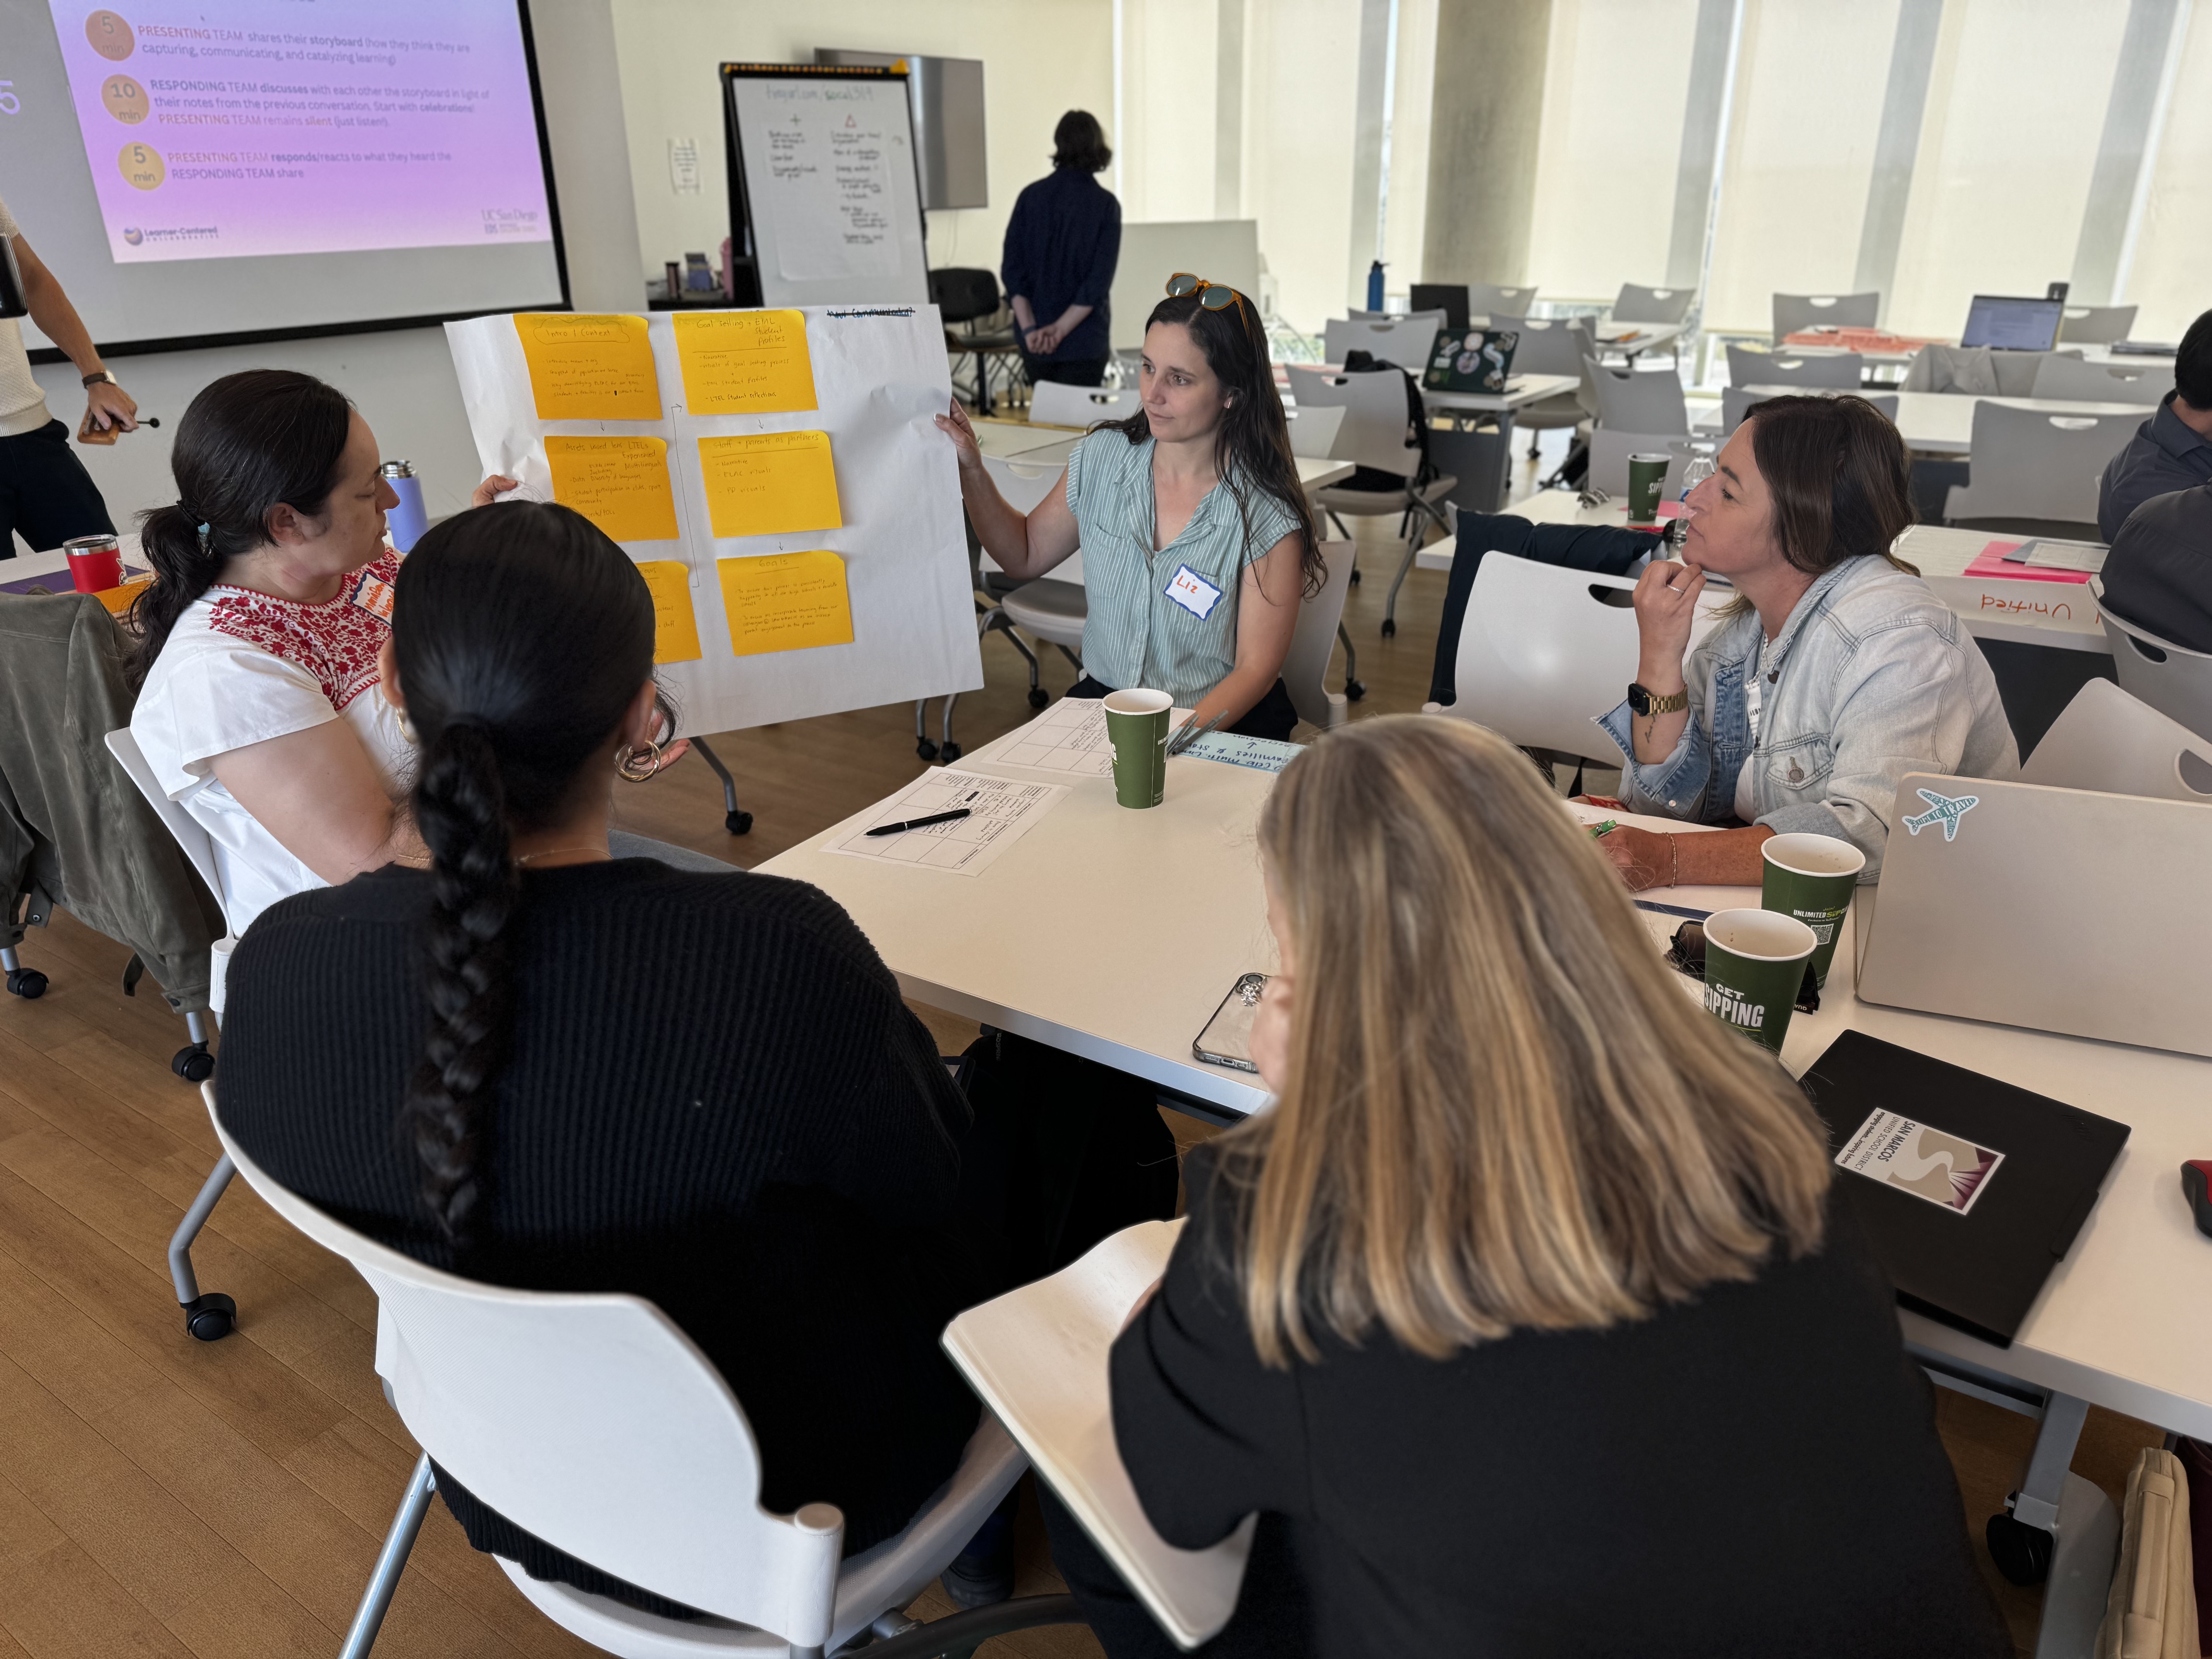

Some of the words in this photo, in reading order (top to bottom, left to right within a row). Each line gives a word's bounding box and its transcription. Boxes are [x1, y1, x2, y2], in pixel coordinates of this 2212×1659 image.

[101, 16, 114, 34] 5
[138, 26, 211, 39] PRESENTING
[212, 30, 243, 41] TEAM
[248, 32, 282, 44] shares
[284, 34, 307, 45] their
[310, 35, 363, 48] storyboard
[365, 37, 387, 49] (how
[389, 39, 409, 51] they
[412, 40, 433, 51] think
[436, 42, 454, 54] they
[102, 43, 124, 53] min
[142, 44, 199, 57] capturing,
[200, 46, 283, 61] communicating,
[286, 50, 304, 60] and
[307, 51, 355, 64] catalyzing
[111, 83, 136, 98] 10
[150, 80, 225, 92] RESPONDING
[227, 82, 258, 93] TEAM
[260, 83, 308, 94] discusses
[311, 85, 330, 95] with
[333, 86, 356, 96] each
[358, 87, 381, 96] other
[385, 88, 399, 97] the
[402, 88, 450, 99] storyboard
[452, 89, 459, 98] in
[155, 97, 180, 107] their
[184, 98, 213, 108] notes
[216, 97, 241, 108] from
[244, 98, 261, 108] the
[263, 98, 306, 110] previous
[374, 101, 396, 111] Start
[398, 102, 417, 111] with
[119, 109, 140, 120] min
[159, 113, 229, 125] PRESENTING
[232, 115, 261, 125] TEAM
[264, 116, 303, 125] remains
[305, 117, 332, 126] silent
[334, 117, 354, 128] (just
[134, 146, 146, 163] 5
[168, 153, 237, 163] PRESENTING
[240, 152, 268, 162] TEAM
[271, 153, 349, 164] responds/reacts
[352, 154, 362, 162] to
[364, 153, 385, 161] what
[388, 152, 407, 163] they
[410, 152, 434, 161] heard
[438, 152, 451, 161] the
[134, 171, 156, 182] min
[172, 169, 244, 180] RESPONDING
[245, 168, 275, 179] TEAM
[277, 168, 304, 178] share
[144, 226, 217, 237] Learner-Centered
[720, 318, 744, 329] setting
[546, 329, 567, 337] Intro
[566, 443, 586, 451] Assets
[746, 437, 771, 449] parents
[788, 433, 819, 445] partners
[622, 449, 655, 460] Experienced
[759, 558, 788, 567] Goals
[1981, 594, 2071, 620] Unified
[1918, 815, 1931, 824] TIME
[1932, 809, 1942, 819] TO
[1943, 798, 1974, 816] TRAVEL
[1793, 909, 1826, 918] UNLIMITED
[1716, 983, 1744, 1000] GET
[1705, 983, 1765, 1027] SIPPING
[1883, 1116, 1901, 1133] UNIFIED
[1898, 1121, 1916, 1136] SAN
[1869, 1133, 1887, 1151] SCHOOL
[1877, 1134, 1906, 1162] MARCOS
[1854, 1151, 1873, 1171] DISTRICT
